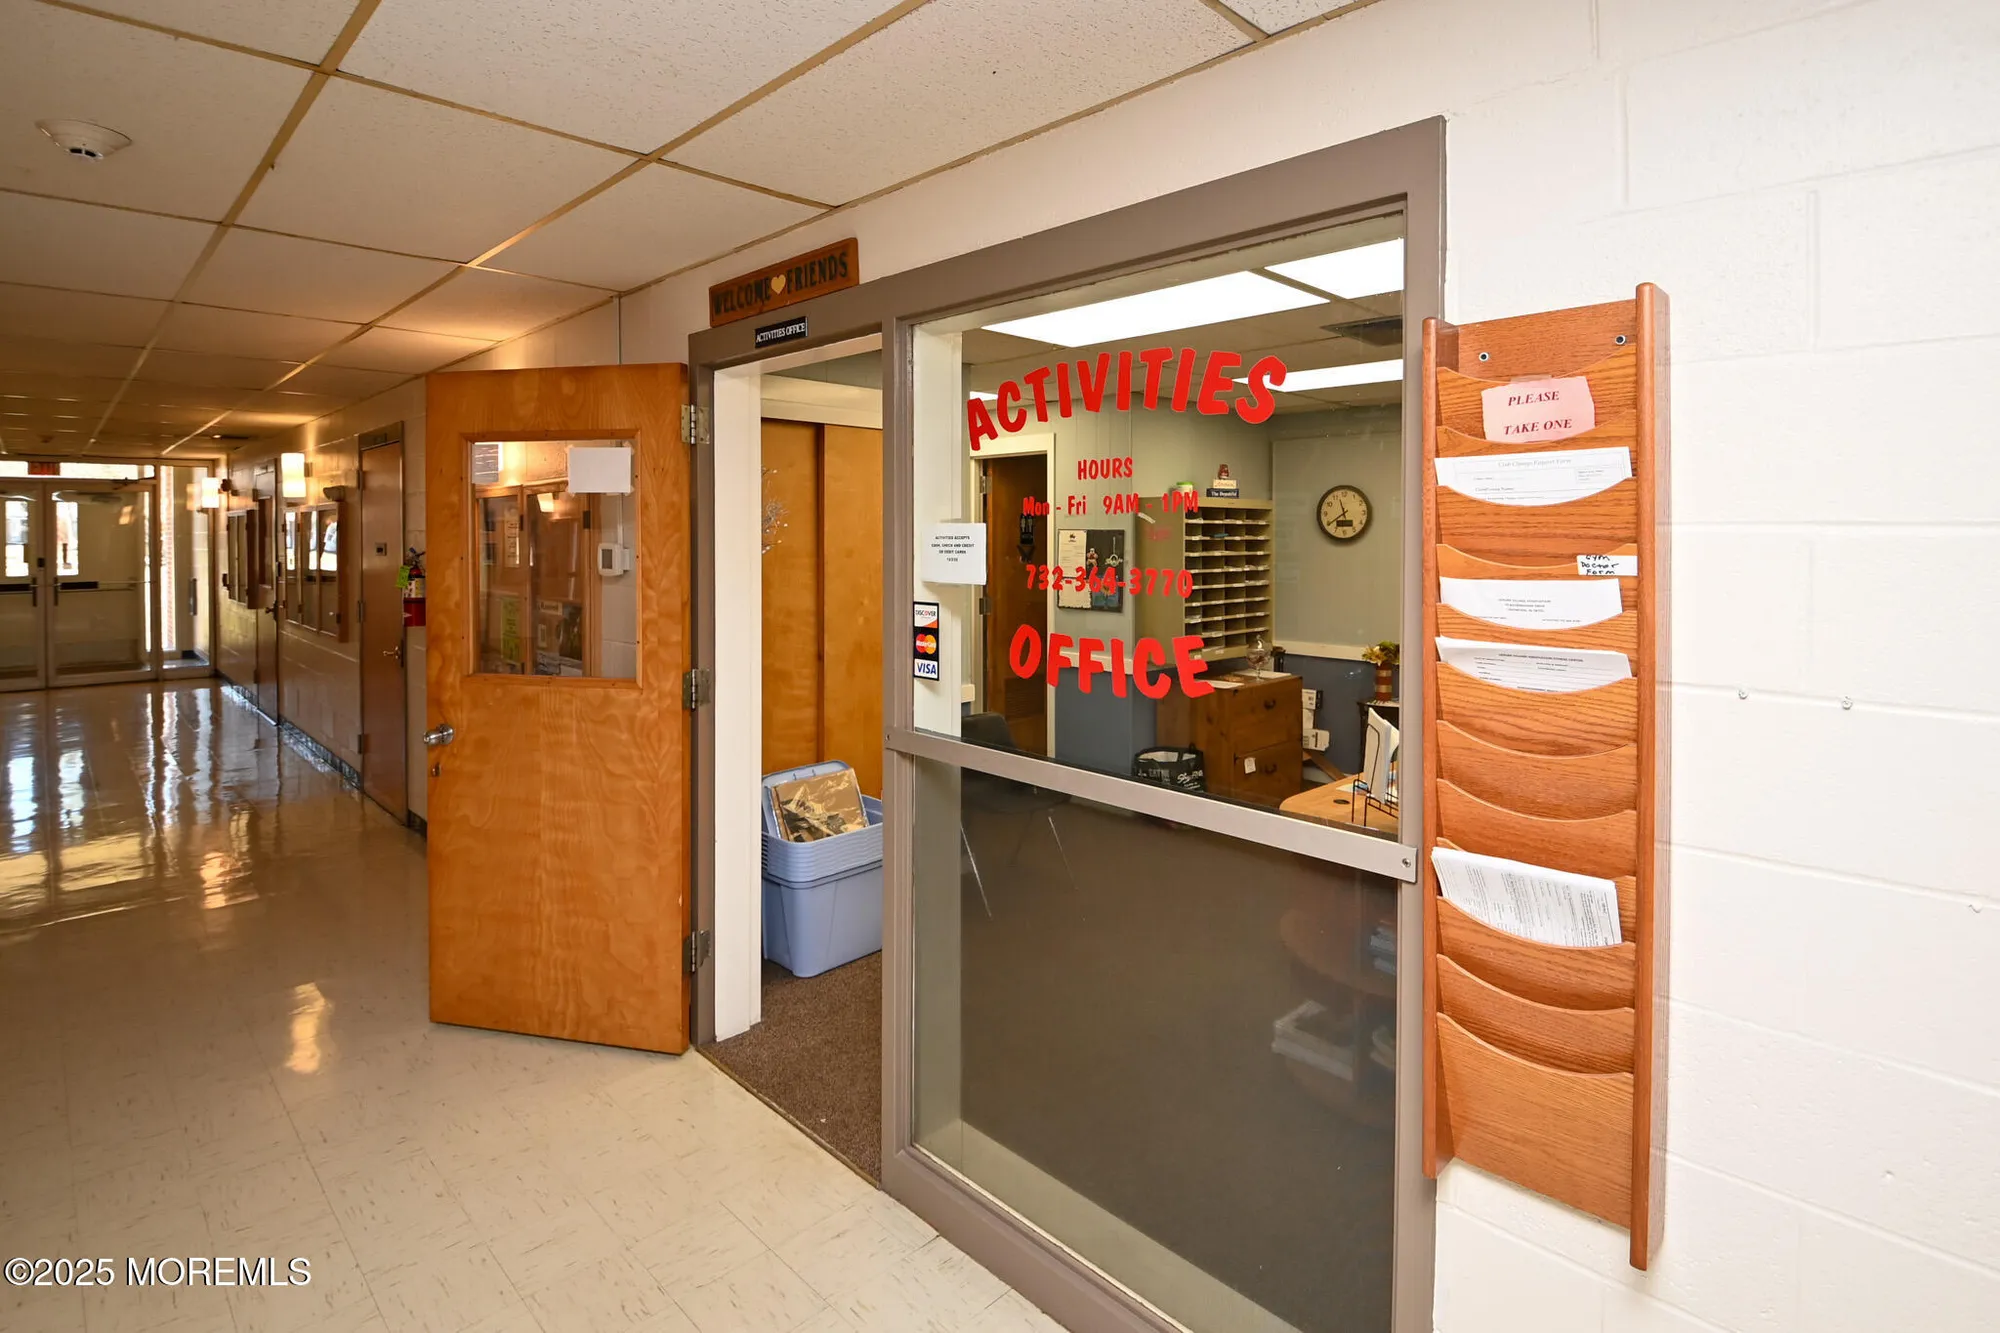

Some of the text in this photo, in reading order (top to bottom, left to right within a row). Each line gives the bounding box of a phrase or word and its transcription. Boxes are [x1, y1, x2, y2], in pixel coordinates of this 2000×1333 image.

[714, 252, 849, 315] WELCOME FRIENDS
[755, 321, 806, 343] ACTIVITIES OFFICE
[966, 347, 1287, 451] ACTIVITIES
[1507, 390, 1560, 406] PLEASE
[1504, 418, 1573, 435] TAKE ONE
[1077, 456, 1133, 480] HOURS
[1023, 495, 1050, 517] Mon
[1068, 494, 1087, 515] Fri
[1102, 492, 1139, 515] 9AM
[1162, 490, 1199, 514] 1PM
[1026, 564, 1193, 599] 732-364-3770
[916, 662, 937, 675] VISA
[1010, 624, 1215, 699] OFFICE
